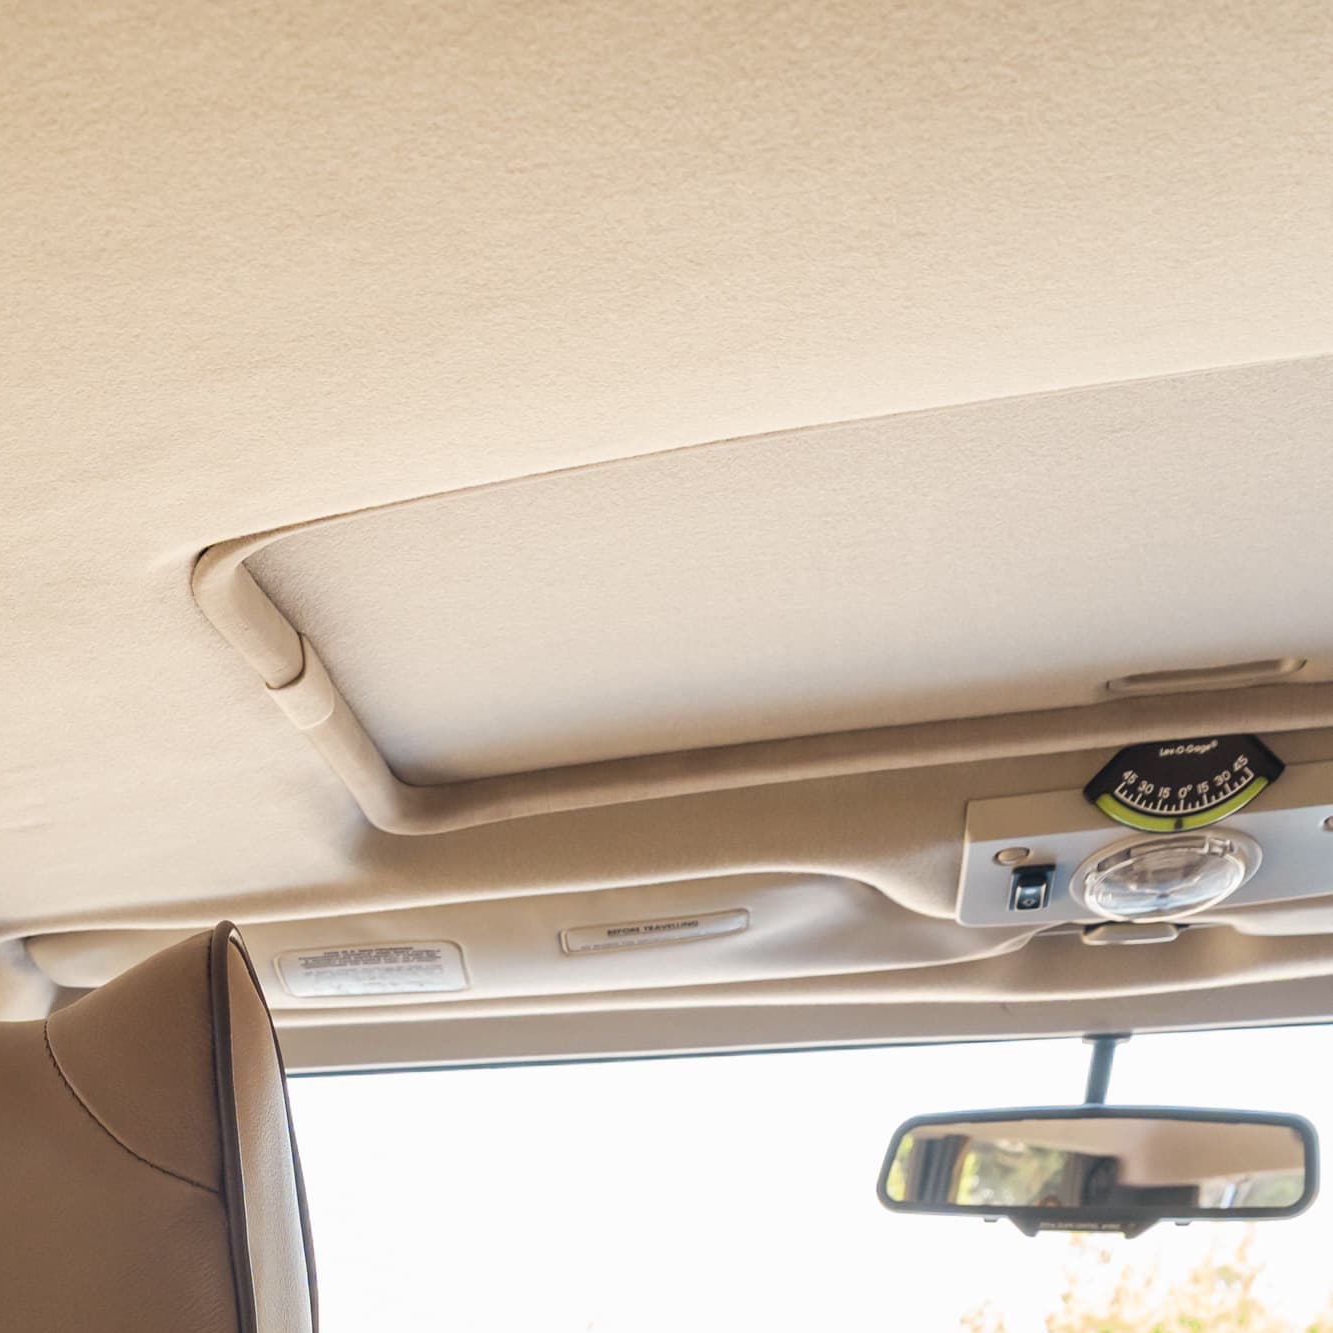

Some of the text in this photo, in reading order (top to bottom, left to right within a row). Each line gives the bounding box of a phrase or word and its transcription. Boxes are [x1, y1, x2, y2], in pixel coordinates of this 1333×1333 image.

[1122, 770, 1139, 785] 45
[1137, 780, 1155, 795] 30
[1157, 786, 1172, 799] 15
[1196, 781, 1210, 795] 15
[1213, 770, 1232, 787] 30
[1233, 754, 1249, 772] 45
